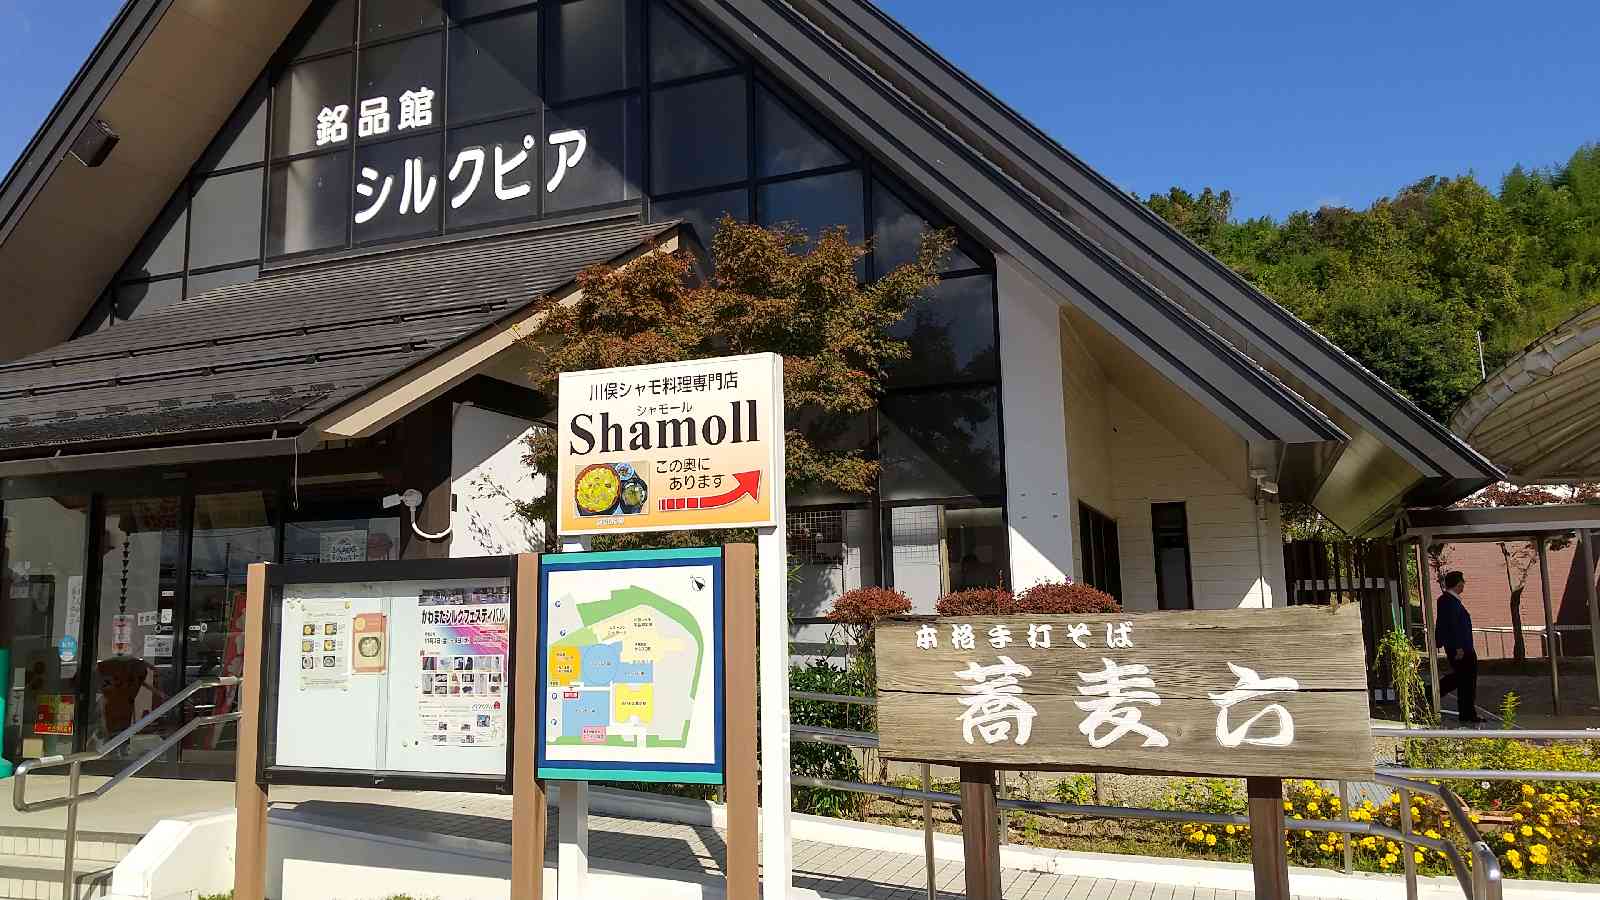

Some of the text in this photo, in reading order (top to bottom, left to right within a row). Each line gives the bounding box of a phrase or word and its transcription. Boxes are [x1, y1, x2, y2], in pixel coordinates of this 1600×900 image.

[316, 87, 434, 146] 銘品館
[354, 129, 587, 223] シルクピア
[590, 372, 738, 400] 川俣シャモ料理専門店
[636, 401, 693, 417] シャモール
[569, 399, 761, 456] Shamoll
[656, 457, 711, 474] この奥に
[669, 473, 725, 491] あります
[421, 608, 506, 624] かわまたシルクフェスティバル
[915, 621, 1135, 650] 本格手打そば
[954, 656, 1300, 748] 蕎麦六
